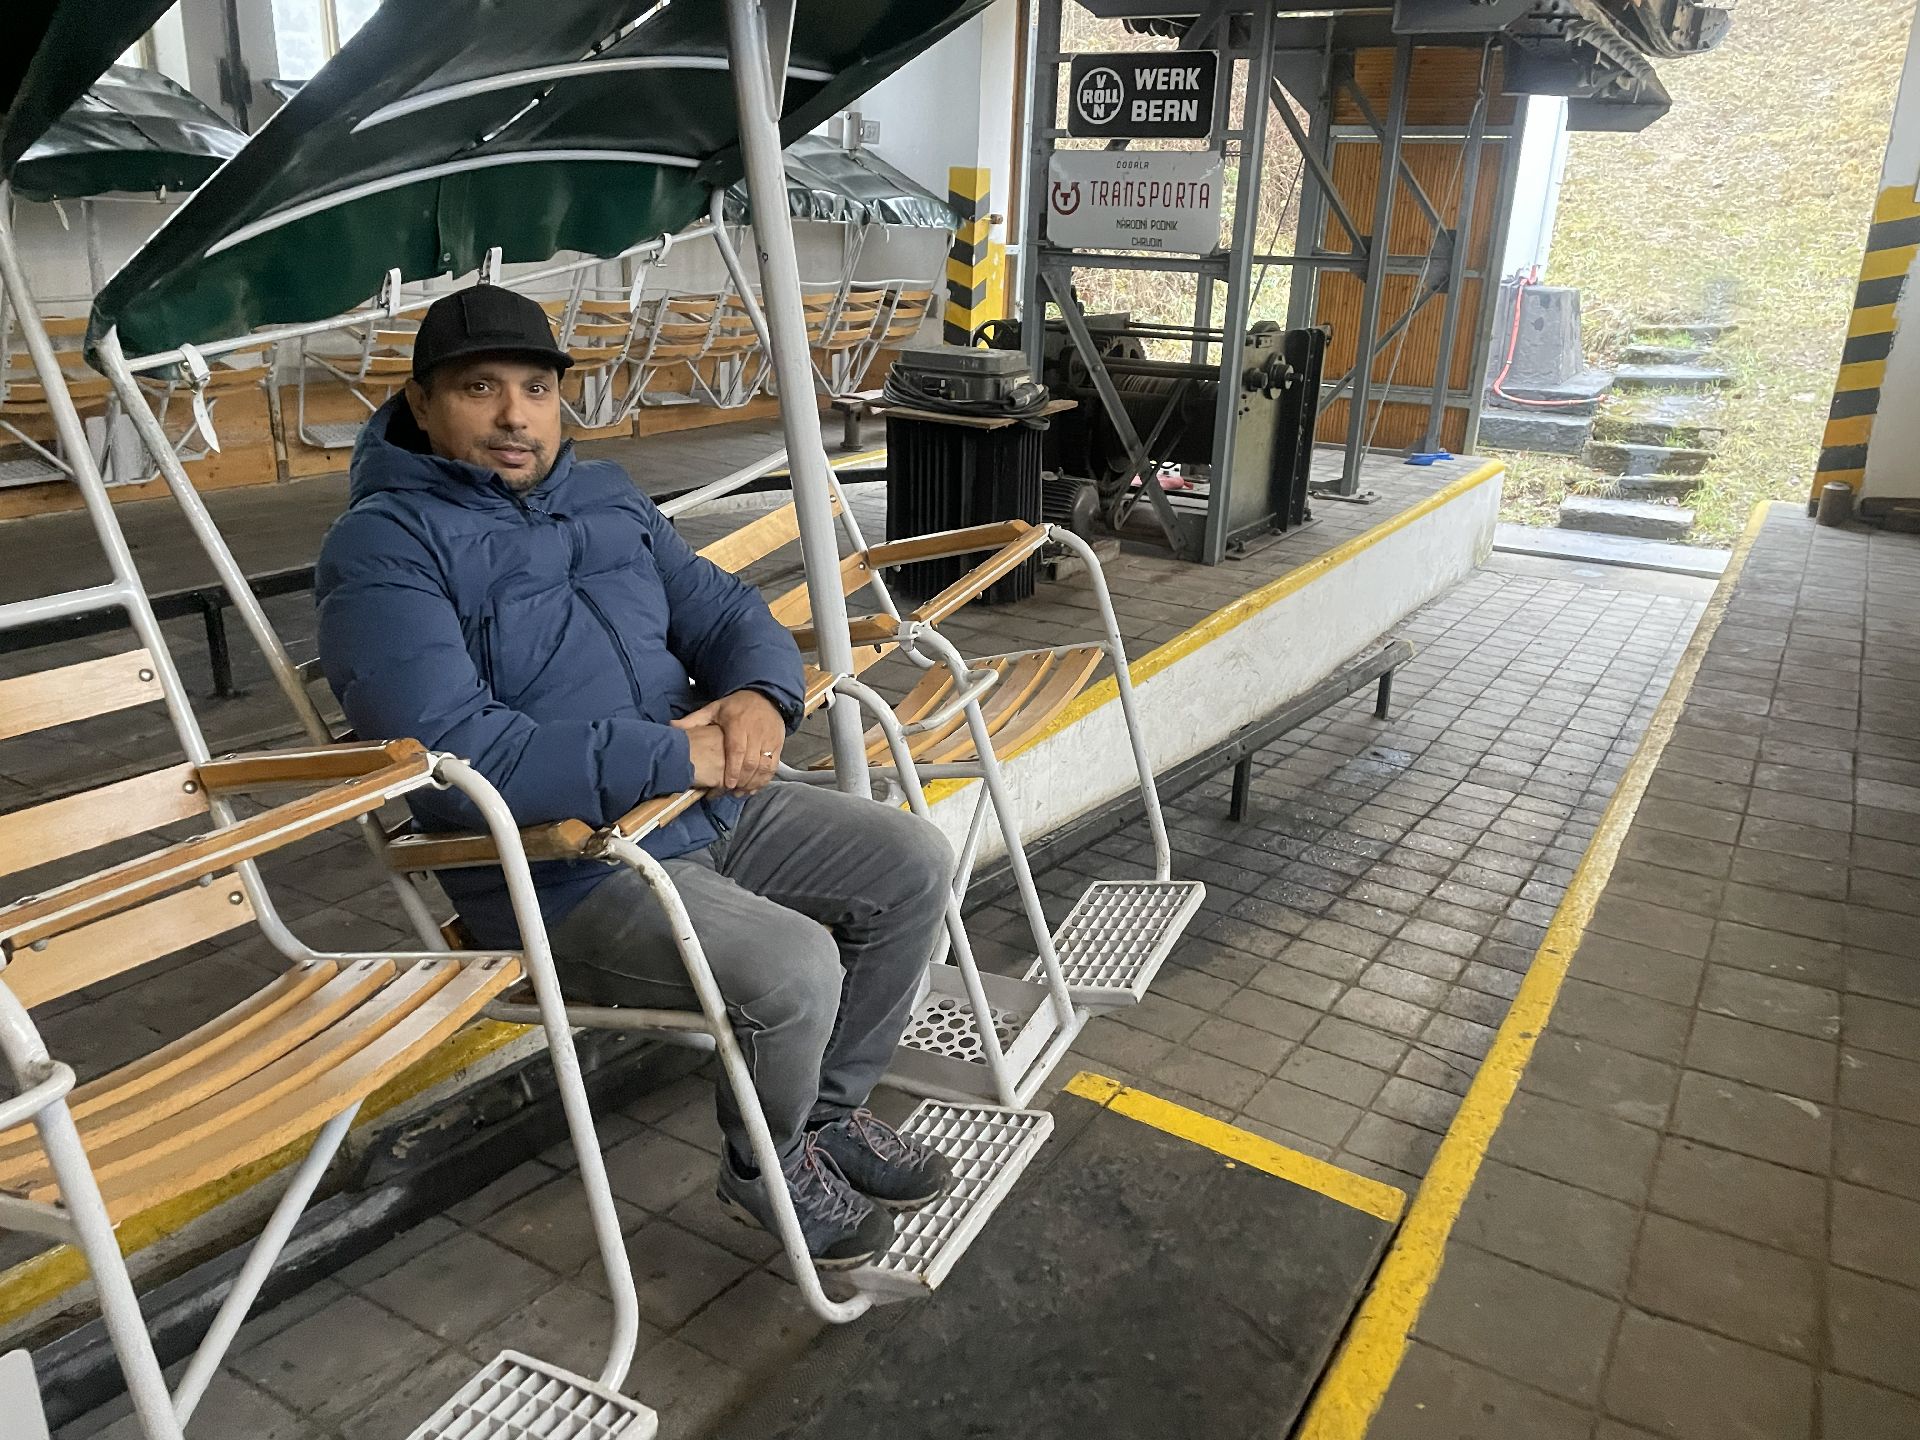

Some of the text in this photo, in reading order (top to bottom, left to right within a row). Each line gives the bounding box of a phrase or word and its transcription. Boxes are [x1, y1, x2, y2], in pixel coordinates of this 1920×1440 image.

[1135, 68, 1201, 90] WERK
[1082, 89, 1119, 103] ROLL
[1131, 100, 1198, 121] BERN
[1090, 181, 1210, 208] TRANSPORTA
